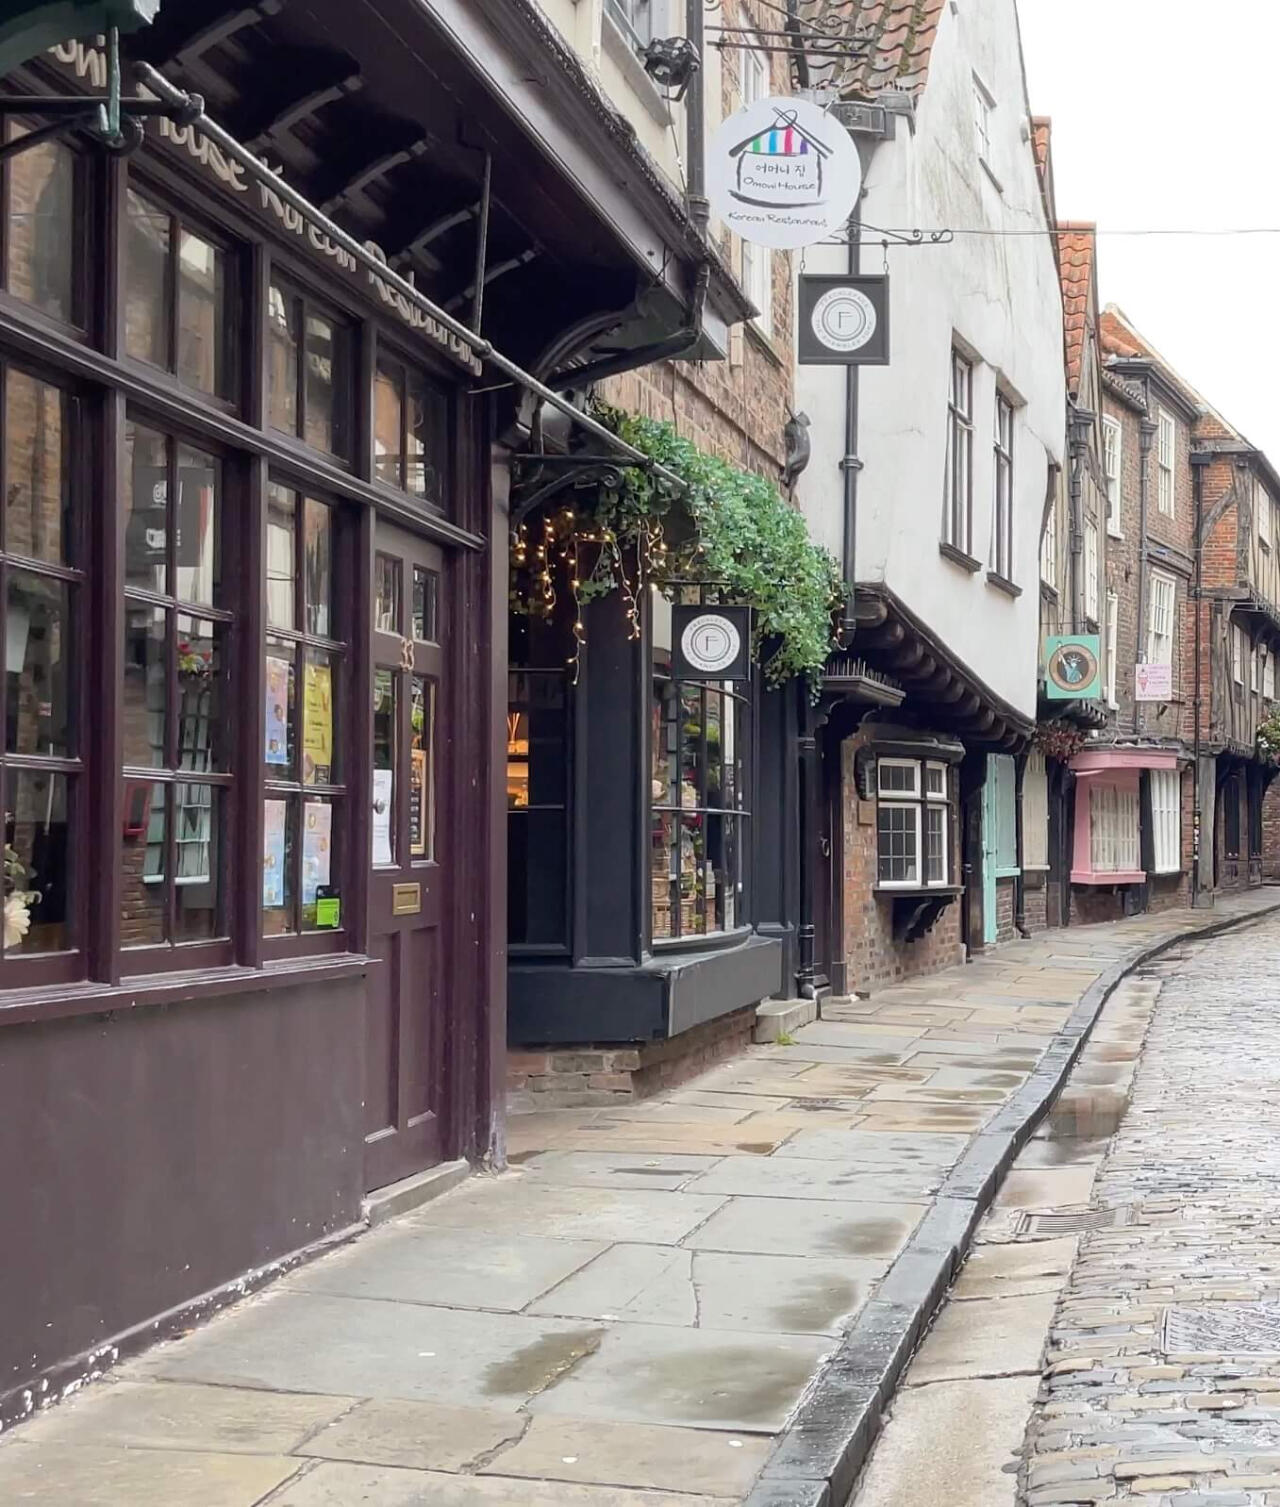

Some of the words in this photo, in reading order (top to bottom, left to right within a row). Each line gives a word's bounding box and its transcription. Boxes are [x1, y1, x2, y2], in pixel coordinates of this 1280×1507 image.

[755, 162, 790, 175] 어머니
[795, 164, 806, 177] 집
[778, 181, 816, 191] House
[728, 211, 765, 222] Korean
[766, 213, 828, 227] Restaurant
